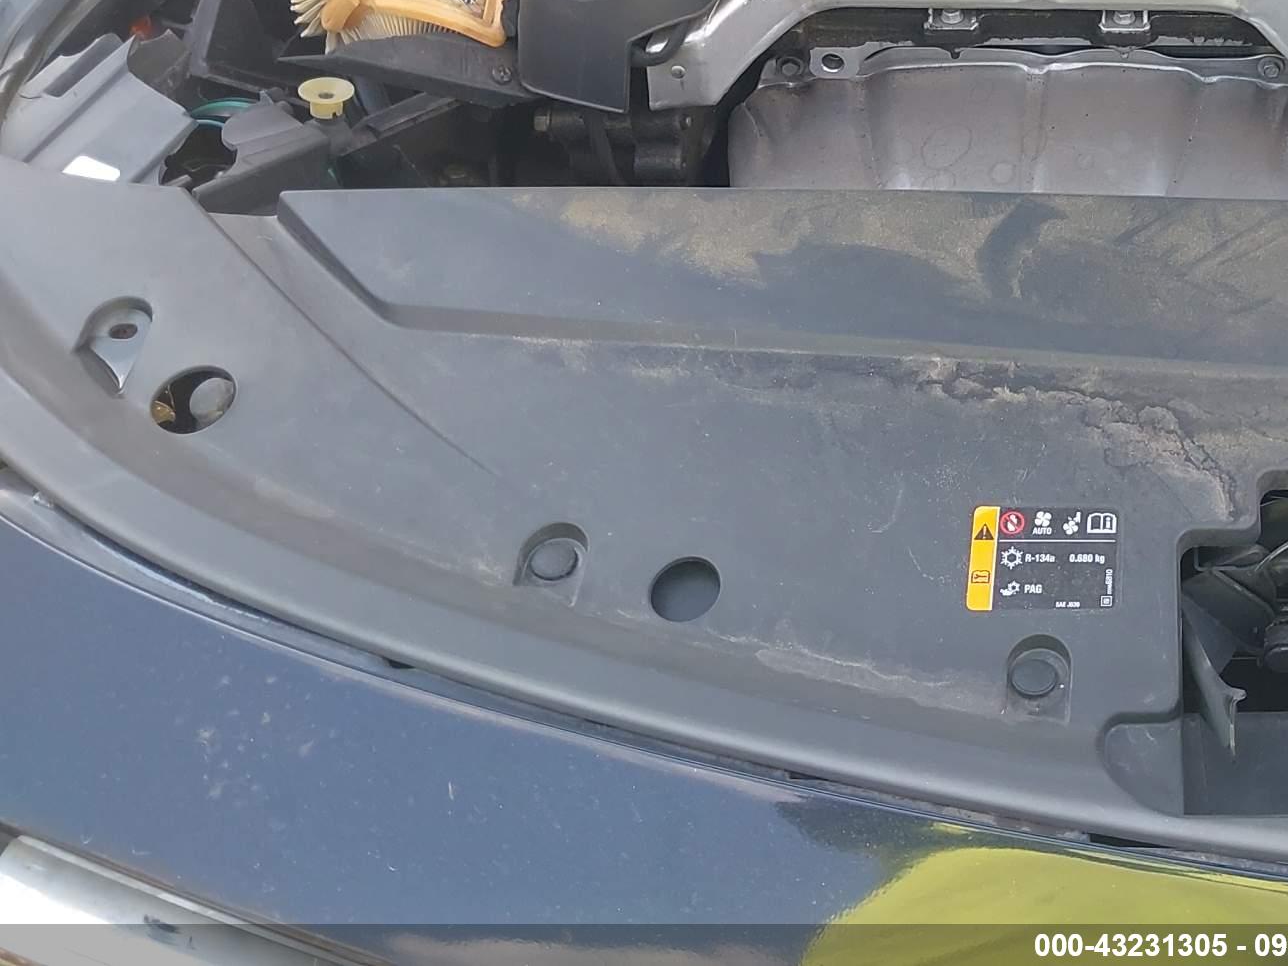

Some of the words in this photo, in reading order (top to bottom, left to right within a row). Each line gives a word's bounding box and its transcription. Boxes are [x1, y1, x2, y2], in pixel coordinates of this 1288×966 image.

[1032, 527, 1052, 535] AUTO
[1025, 553, 1055, 563] R-134a
[1094, 553, 1105, 565] kg
[1024, 584, 1042, 594] PAG
